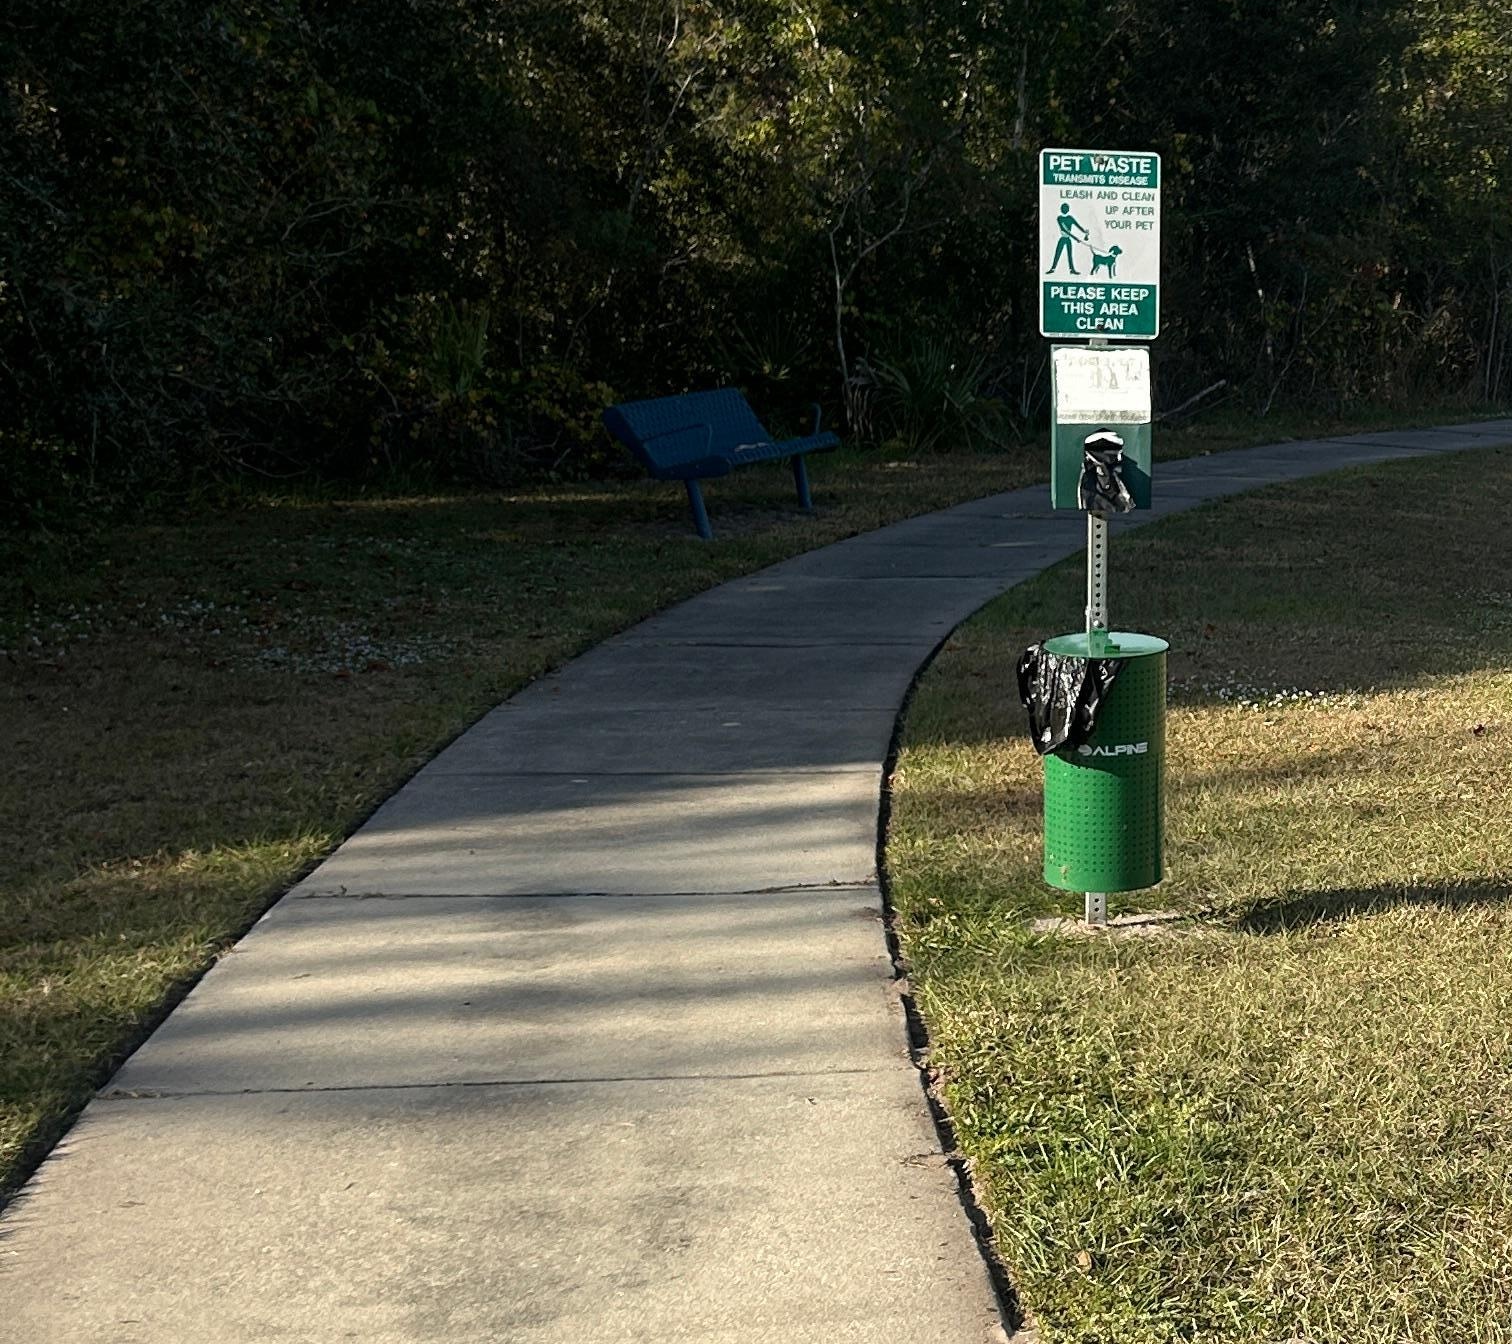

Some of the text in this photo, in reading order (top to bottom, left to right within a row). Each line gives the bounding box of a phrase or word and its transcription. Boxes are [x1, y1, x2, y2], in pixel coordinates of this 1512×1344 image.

[1049, 155, 1152, 174] PET WASTE
[1053, 173, 1149, 186] TRANSMITS DISEASE
[1060, 189, 1155, 201] LEASH AND CLEAN
[1105, 205, 1154, 216] UP AFTER
[1104, 219, 1154, 230] YOUR PET
[1050, 286, 1149, 301] PLEASE KEEP
[1060, 301, 1138, 315] THIS AREA
[1076, 317, 1124, 330] CLEAN
[1092, 741, 1148, 756] ALPINE
